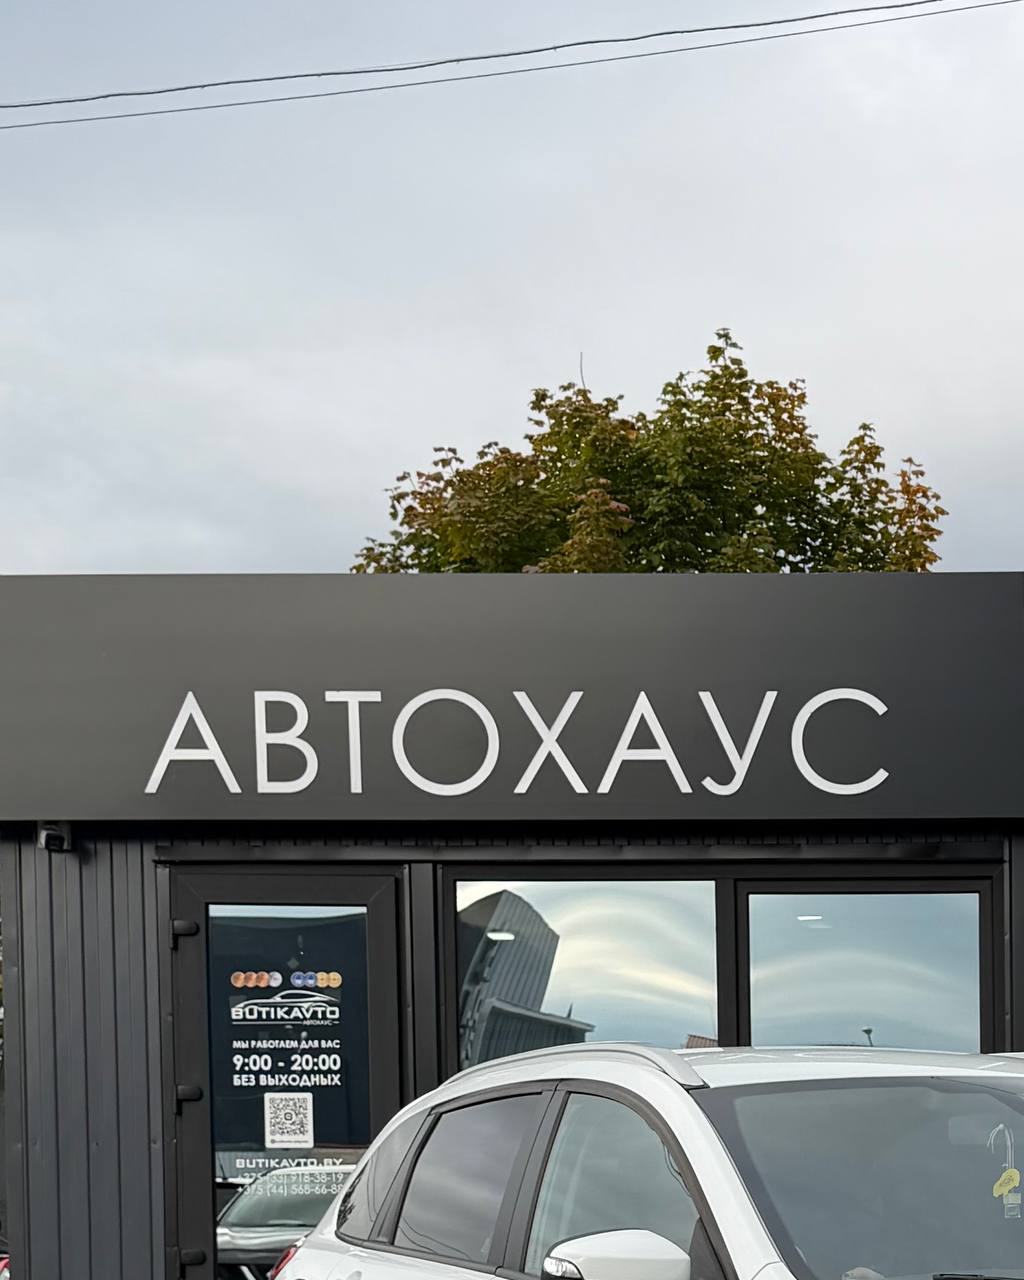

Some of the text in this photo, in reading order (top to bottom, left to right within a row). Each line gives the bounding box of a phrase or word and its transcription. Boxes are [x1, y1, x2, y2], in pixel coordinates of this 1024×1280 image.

[143, 687, 890, 797] АВТОХАУС
[230, 1006, 340, 1020] BUTIKAVTO
[232, 1040, 341, 1049] МЫ РАБОТАЕМ ДЛЯ ВАС
[232, 1054, 272, 1071] 9:00
[290, 1053, 342, 1071] 20:00
[233, 1073, 342, 1087] БЕЗ ВЫХОДНЫХ
[235, 1158, 343, 1168] BUTIKAVTO.BY
